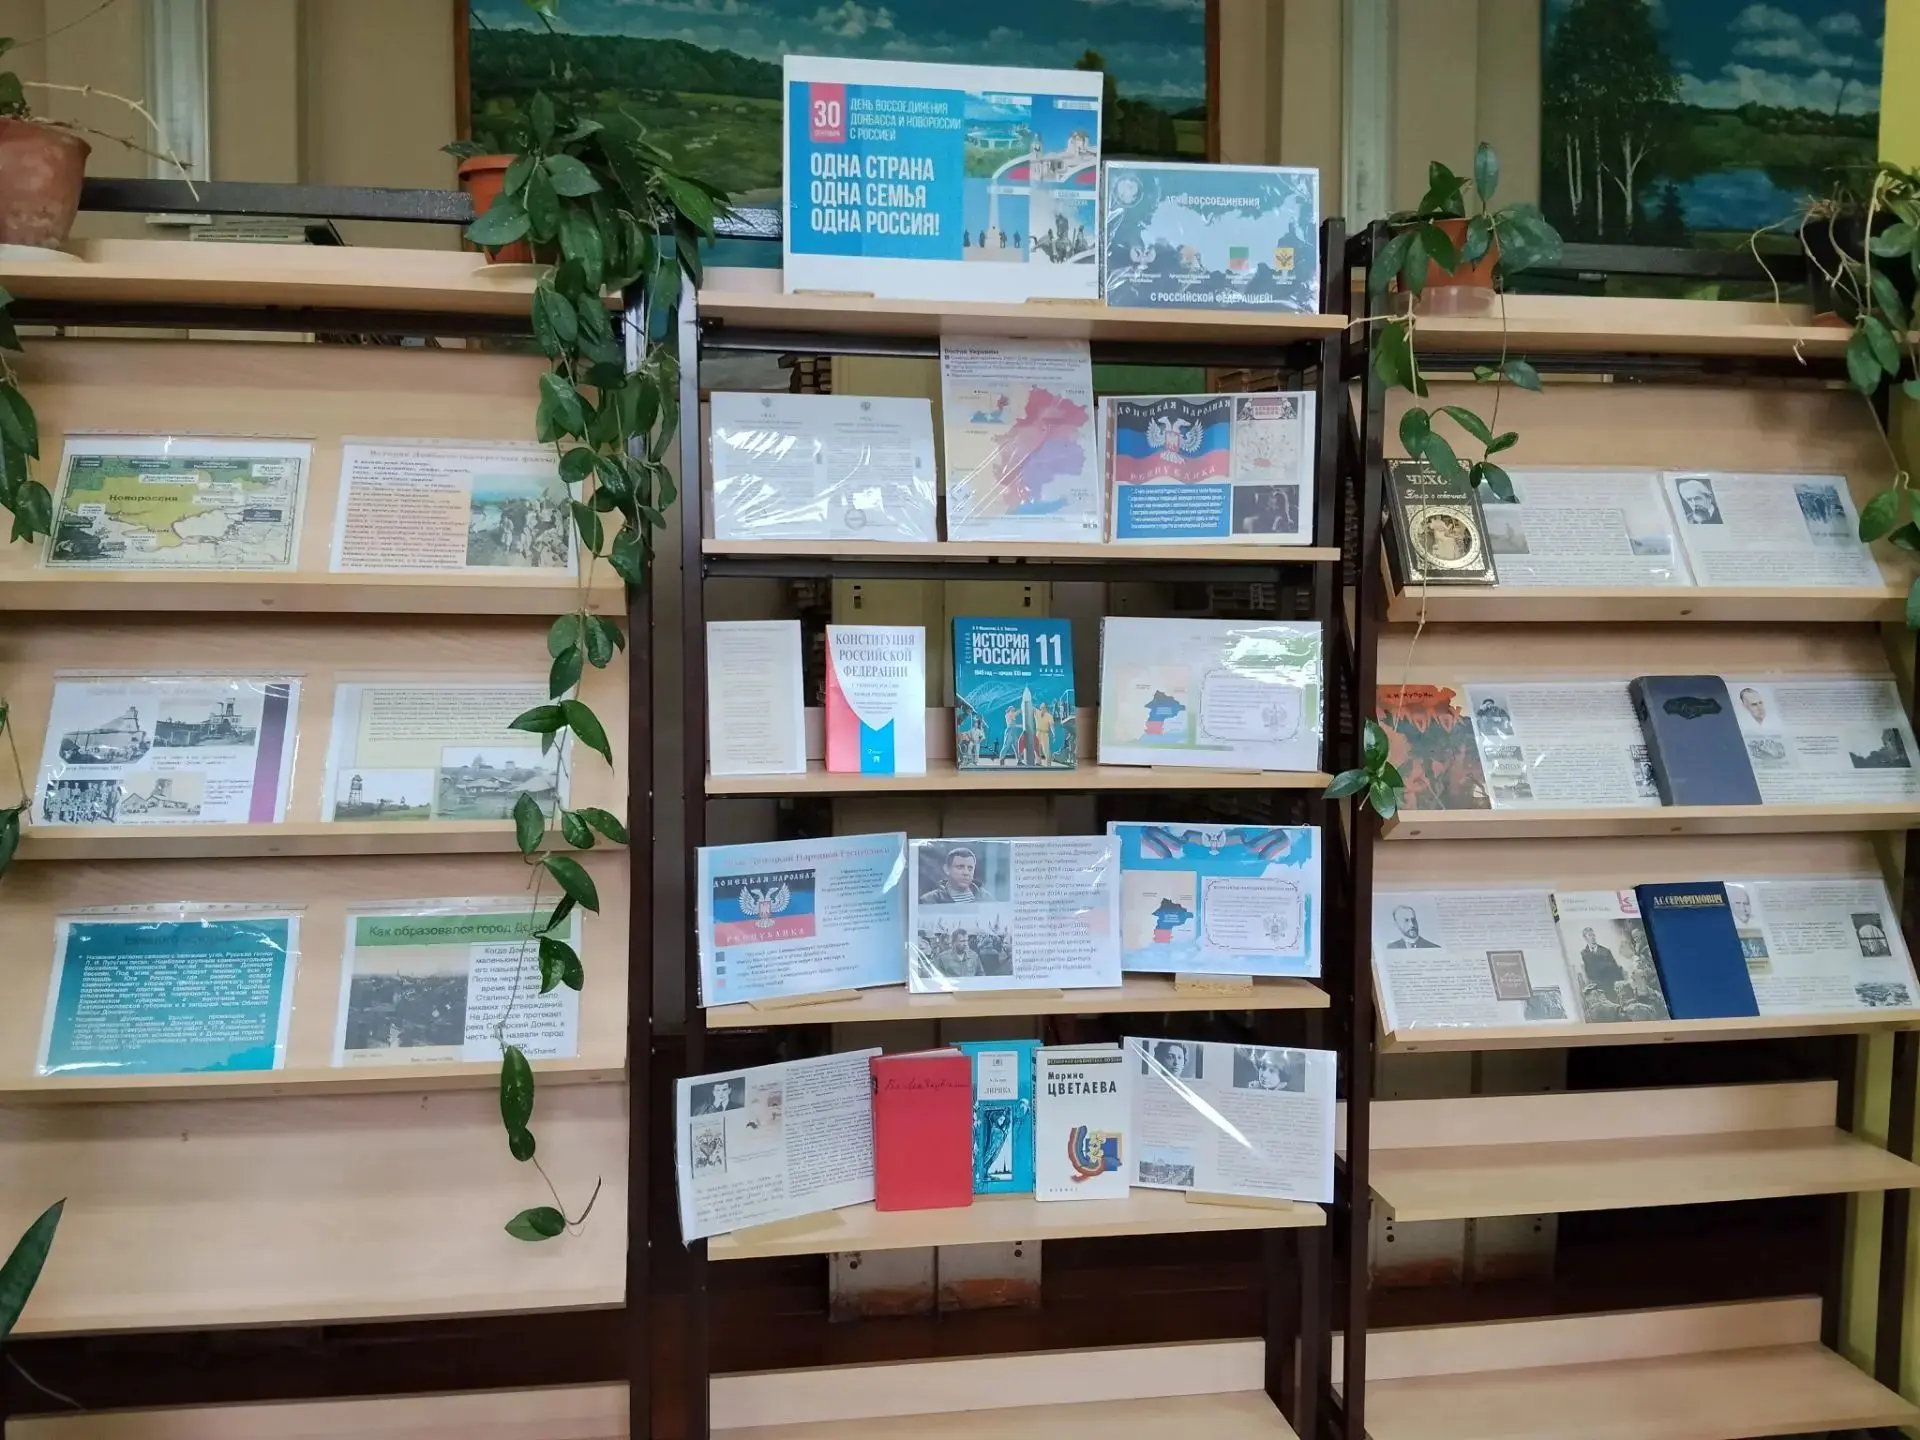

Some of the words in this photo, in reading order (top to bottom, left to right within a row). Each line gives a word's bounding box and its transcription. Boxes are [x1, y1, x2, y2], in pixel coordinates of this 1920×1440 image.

[850, 99, 873, 110] ДЕНЬ
[875, 100, 948, 114] ВОССОЕДИНЕНИЯ
[814, 101, 840, 128] 30
[850, 113, 896, 126] ДОНБАССА
[899, 115, 906, 126] И
[907, 116, 961, 130] НОВОРОССИИ
[850, 128, 856, 140] С
[858, 127, 896, 140] РОССИЕЙ
[811, 152, 861, 179] ОДНА
[866, 155, 934, 181] СТРАНА
[811, 181, 861, 207] ОДНА
[866, 183, 926, 208] СЕМЬЯ
[1188, 196, 1260, 207] ВОССОЕДИНЕНИЯ
[811, 208, 861, 234] ОДНА
[866, 211, 940, 236] РОССИЯ!
[1150, 292, 1157, 301] С
[1158, 292, 1214, 303] РОССИЙСКОЙ
[1117, 401, 1177, 417] ДОНЕЦКАЯ
[1183, 400, 1231, 417] НАРОДНАЯ
[1130, 465, 1216, 481] РЕСПУБЛИКА
[109, 494, 178, 503] Новороссия
[835, 633, 915, 646] КОНСТИТУЦИЯ
[839, 648, 912, 662] РОССИЙСКОЙ
[972, 633, 1029, 648] ИСТОРИЯ
[1035, 634, 1062, 665] 11
[973, 648, 1030, 665] РОССИИ
[843, 666, 908, 678] ФЕДЕРАЦИИ
[713, 877, 769, 888] ДОНЕЦКАЯ
[772, 872, 816, 883] НАРОДНАЯ
[369, 925, 391, 936] Как
[394, 921, 474, 936] образовался
[476, 922, 511, 936] город
[727, 928, 805, 943] РЕСПУБЛИКА
[1048, 1072, 1084, 1081] Марина
[1048, 1081, 1117, 1097] ЦВЕТАЕВА
